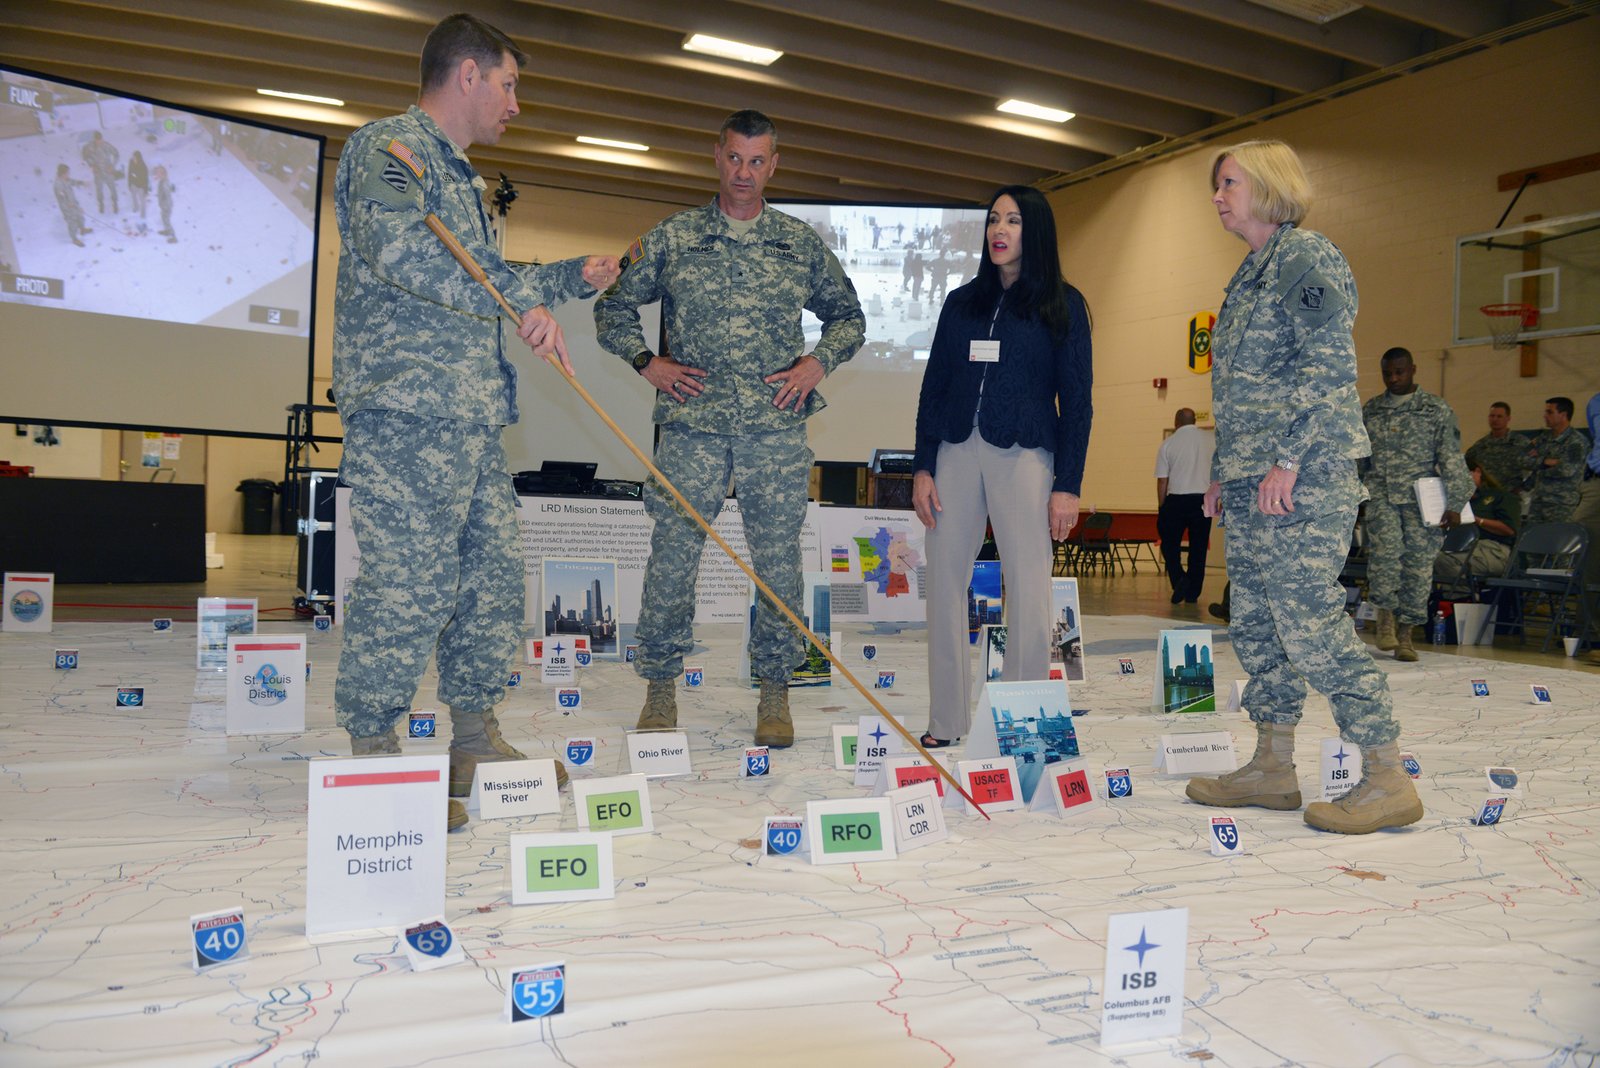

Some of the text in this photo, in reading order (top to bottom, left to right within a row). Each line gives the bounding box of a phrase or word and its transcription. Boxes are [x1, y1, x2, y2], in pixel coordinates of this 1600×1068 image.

[16, 277, 49, 296] PHOTO
[541, 504, 644, 516] LRD Mission Statement
[720, 504, 741, 513] SACE
[57, 655, 75, 666] 80
[1122, 662, 1132, 671] 70
[244, 675, 292, 685] St. Louis
[686, 672, 701, 683] 74
[880, 676, 893, 685] 74
[121, 692, 139, 703] 72
[249, 689, 287, 699] District
[562, 696, 576, 705] 57
[413, 721, 430, 733] 64
[570, 748, 588, 760] 57
[638, 748, 684, 758] Ohio River
[867, 747, 886, 757] ISB
[1166, 744, 1230, 754] Cumberland River
[751, 757, 766, 770] 24
[1404, 760, 1419, 770] 40
[974, 773, 1006, 786] USACE
[1332, 769, 1349, 780] ISB
[484, 777, 542, 792] Mississippi
[1112, 778, 1128, 792] 24
[1498, 776, 1512, 786] 75
[986, 788, 998, 798] TF
[1064, 780, 1086, 798] LRN
[502, 794, 528, 803] River
[596, 802, 632, 820] EFO
[906, 803, 925, 818] LRN
[1484, 807, 1500, 819] 24
[831, 824, 872, 842] RFO
[910, 820, 930, 836] CDR
[336, 830, 424, 851] Memphis
[773, 831, 798, 847] 40
[1218, 826, 1236, 843] 65
[347, 856, 413, 876] District
[540, 858, 588, 878] EFO
[200, 916, 234, 929] INTERSTATE
[204, 928, 240, 952] 40
[416, 930, 448, 952] 69
[1122, 971, 1157, 990] ISB
[523, 980, 556, 1010] 55
[1104, 996, 1172, 1010] Columbus AFB
[1107, 1011, 1150, 1022] (Supporting
